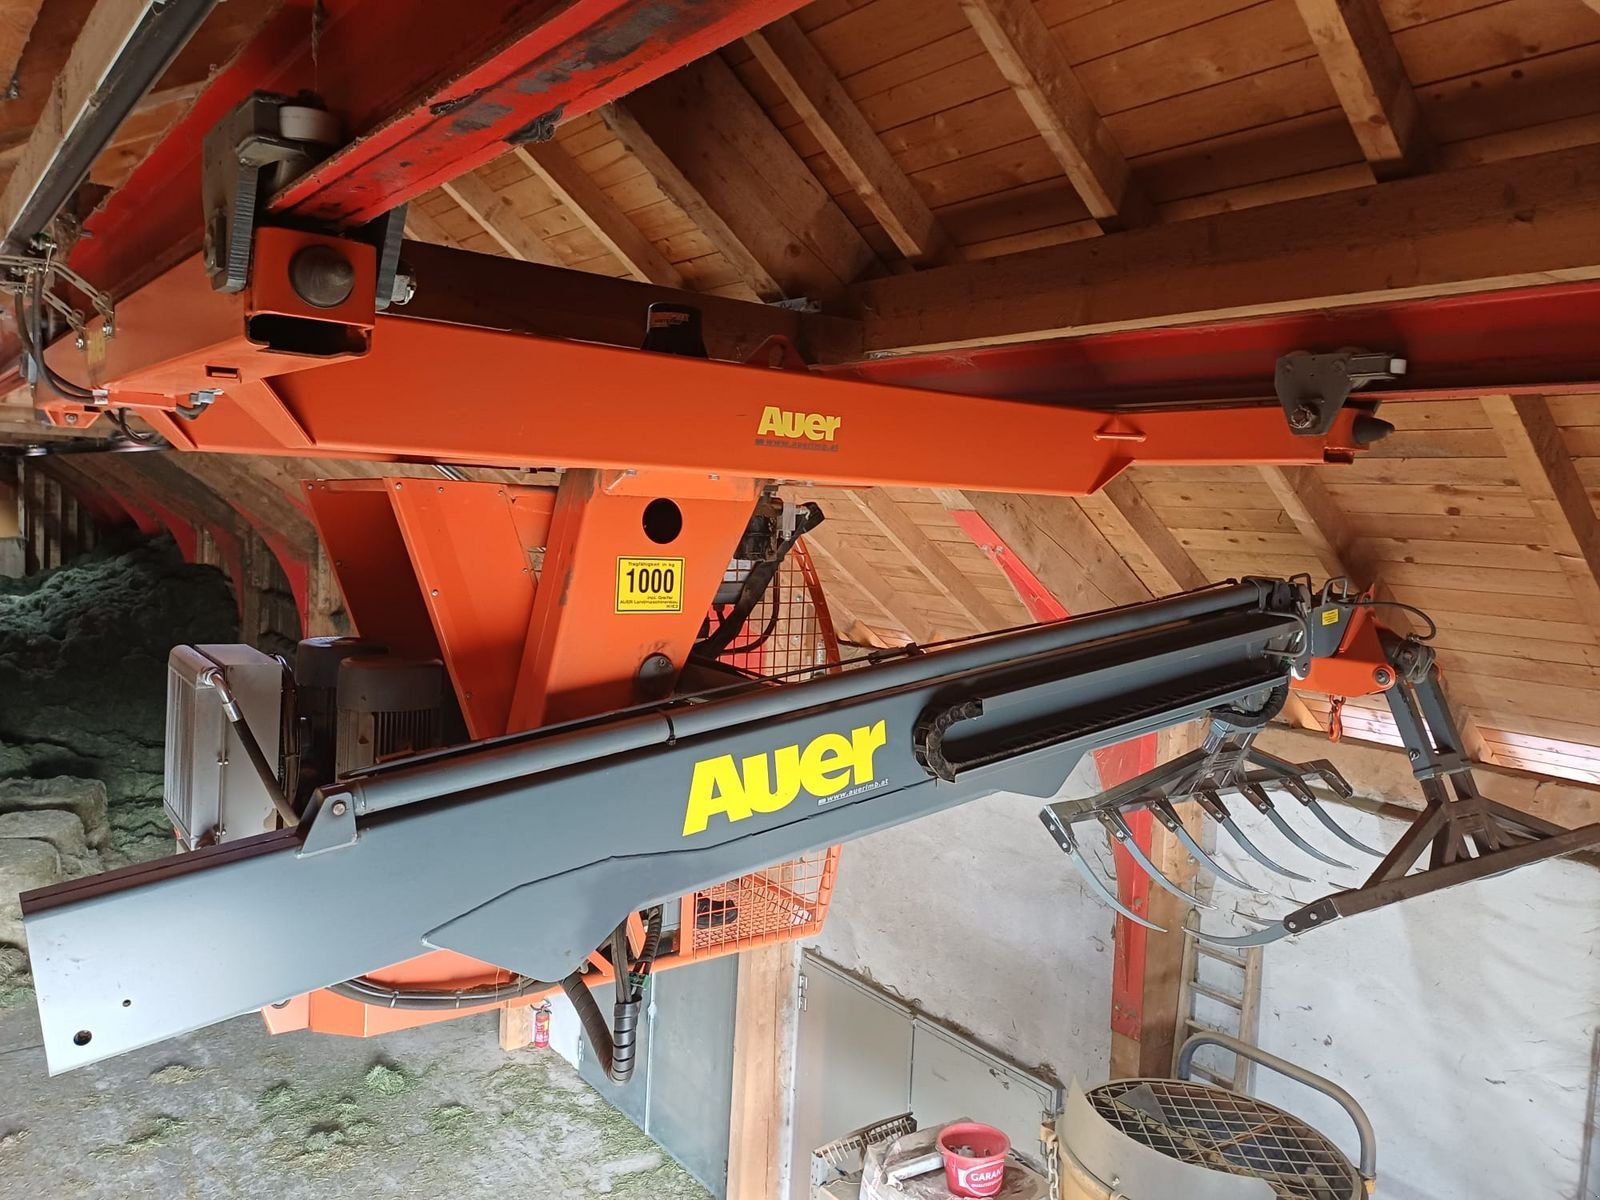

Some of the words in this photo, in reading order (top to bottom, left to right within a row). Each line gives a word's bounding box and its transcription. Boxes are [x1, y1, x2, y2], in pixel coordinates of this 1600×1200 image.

[757, 406, 841, 440] Auer
[626, 568, 674, 593] 1000
[682, 720, 886, 836] Auer
